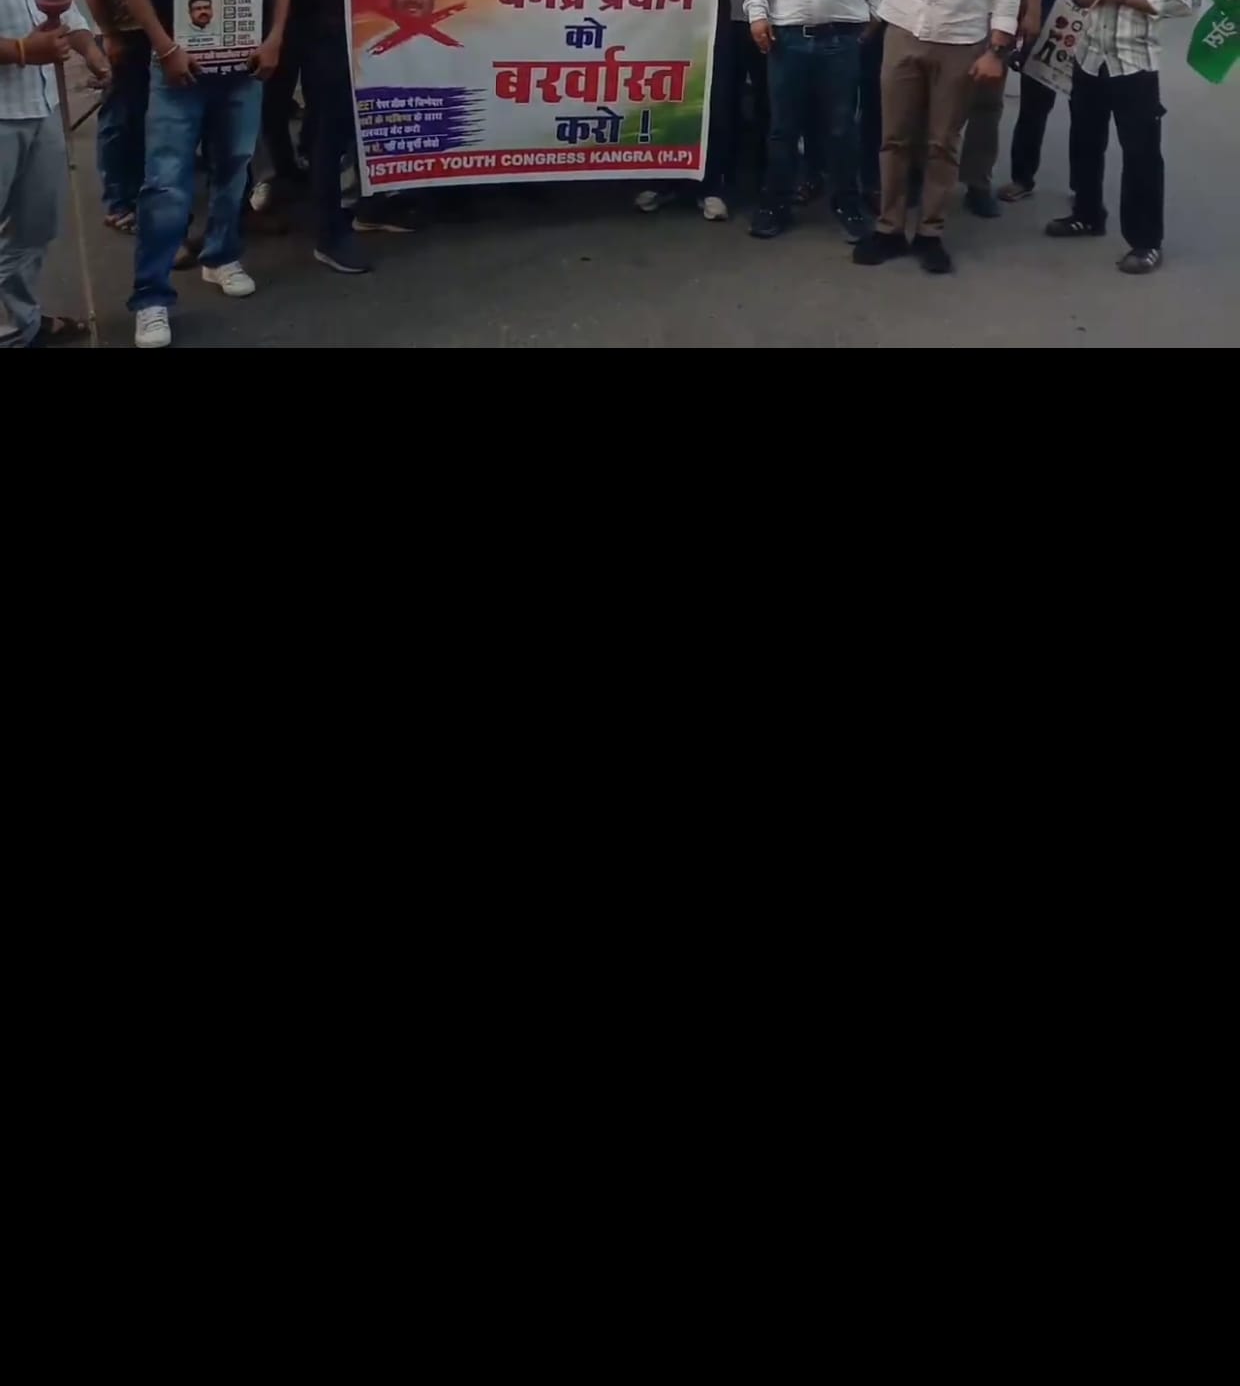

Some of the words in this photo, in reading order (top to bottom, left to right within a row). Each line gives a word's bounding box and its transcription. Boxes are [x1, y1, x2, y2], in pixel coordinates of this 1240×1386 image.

[565, 17, 607, 48] को
[358, 99, 375, 111] EET
[555, 106, 624, 144] करो
[639, 110, 650, 143] !
[440, 155, 496, 170] YOUTH
[501, 151, 586, 166] CONGRESS
[590, 150, 654, 164] KANGRA
[657, 150, 693, 165] (H.P)
